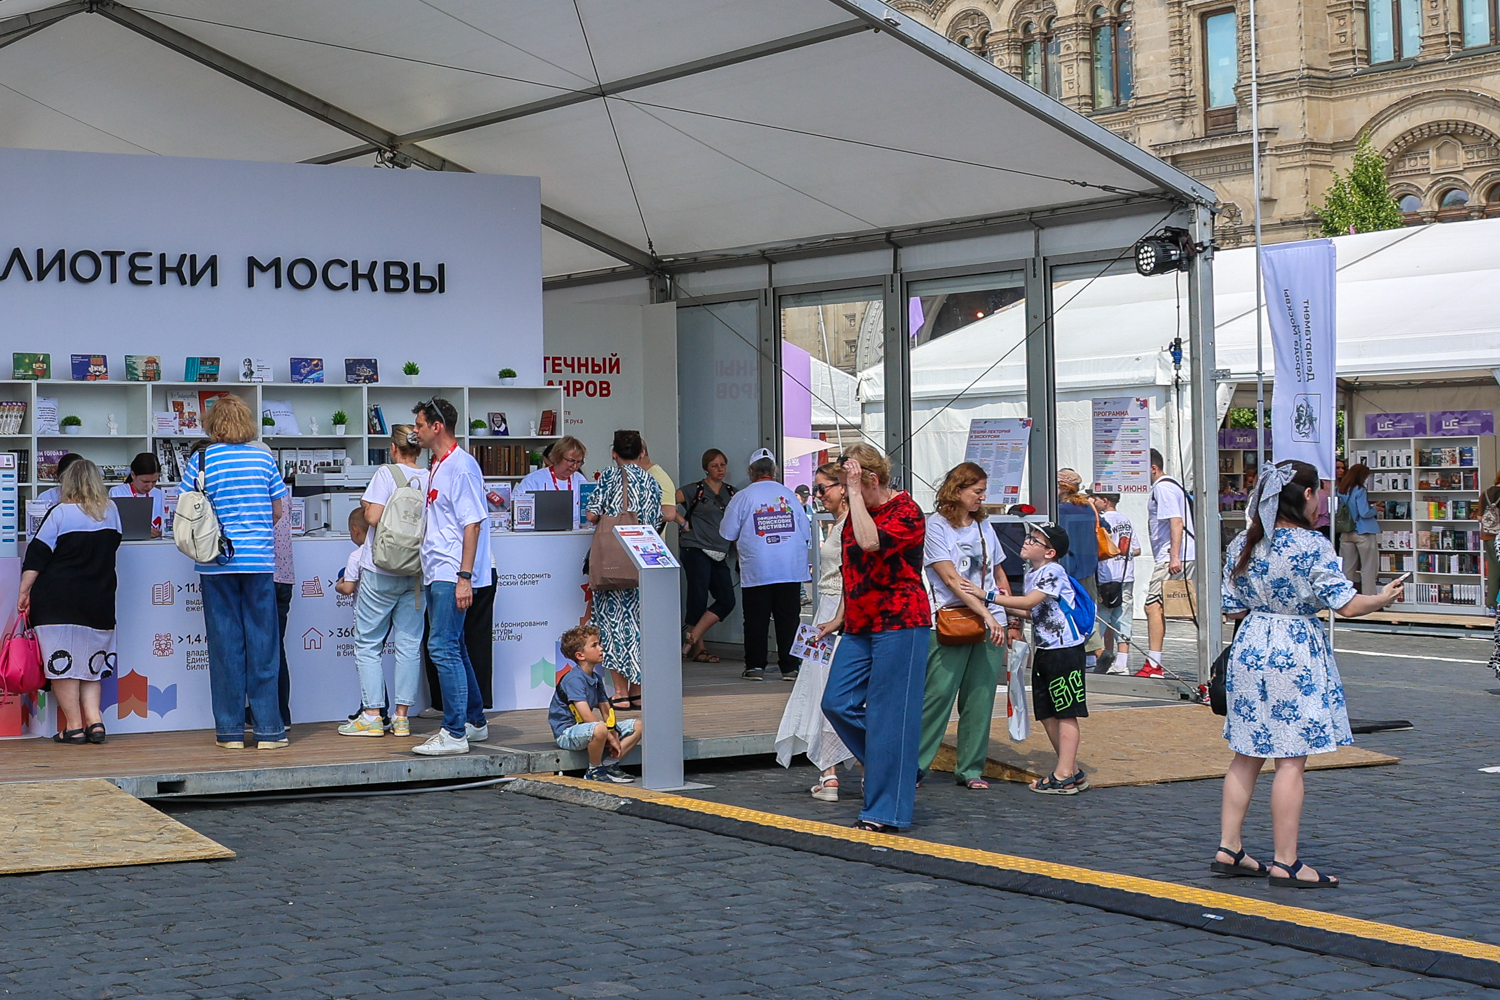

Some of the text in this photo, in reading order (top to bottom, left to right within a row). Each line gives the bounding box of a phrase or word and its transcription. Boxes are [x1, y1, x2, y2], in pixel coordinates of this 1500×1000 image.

[248, 256, 446, 294] МОСКВЫ
[500, 620, 548, 628] бронирование
[186, 634, 201, 645] 1,4
